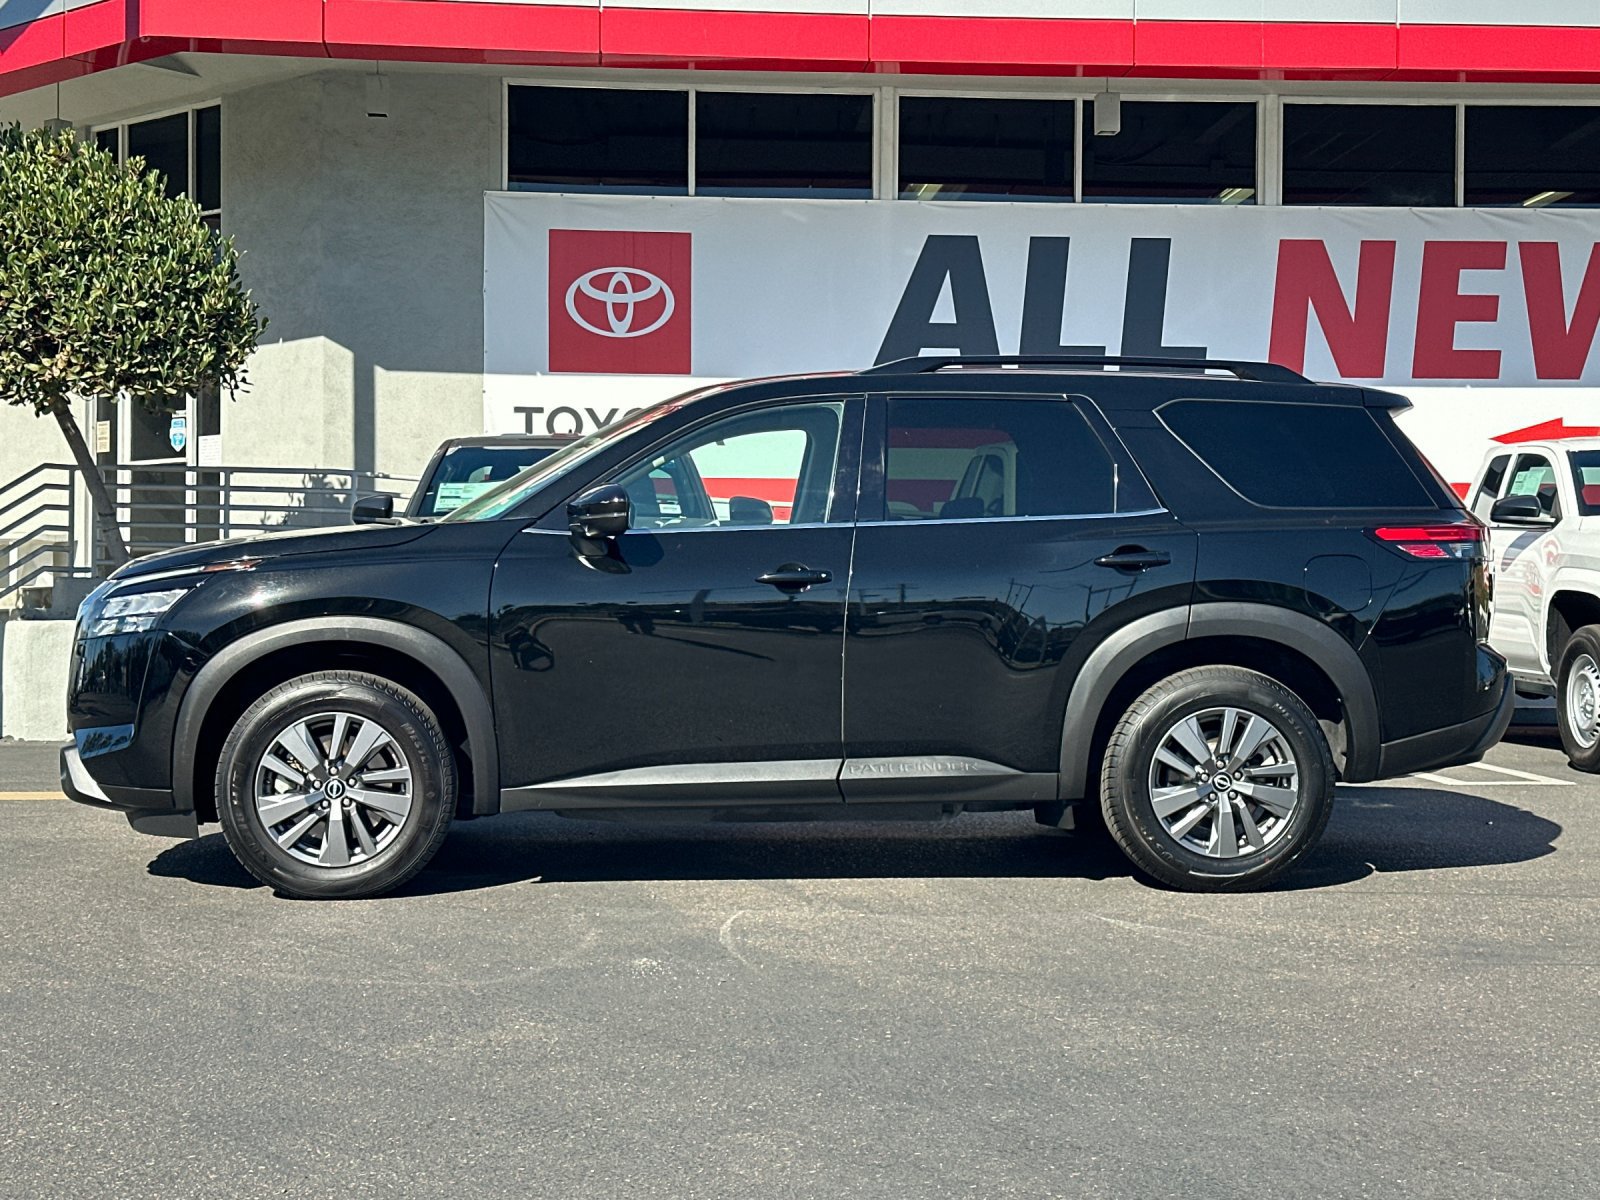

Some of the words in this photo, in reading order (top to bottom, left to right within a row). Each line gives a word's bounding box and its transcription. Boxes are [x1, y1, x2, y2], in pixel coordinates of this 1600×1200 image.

[872, 234, 1208, 369] ALL
[513, 405, 646, 434] TOY
[848, 761, 979, 775] PATHFINDER
